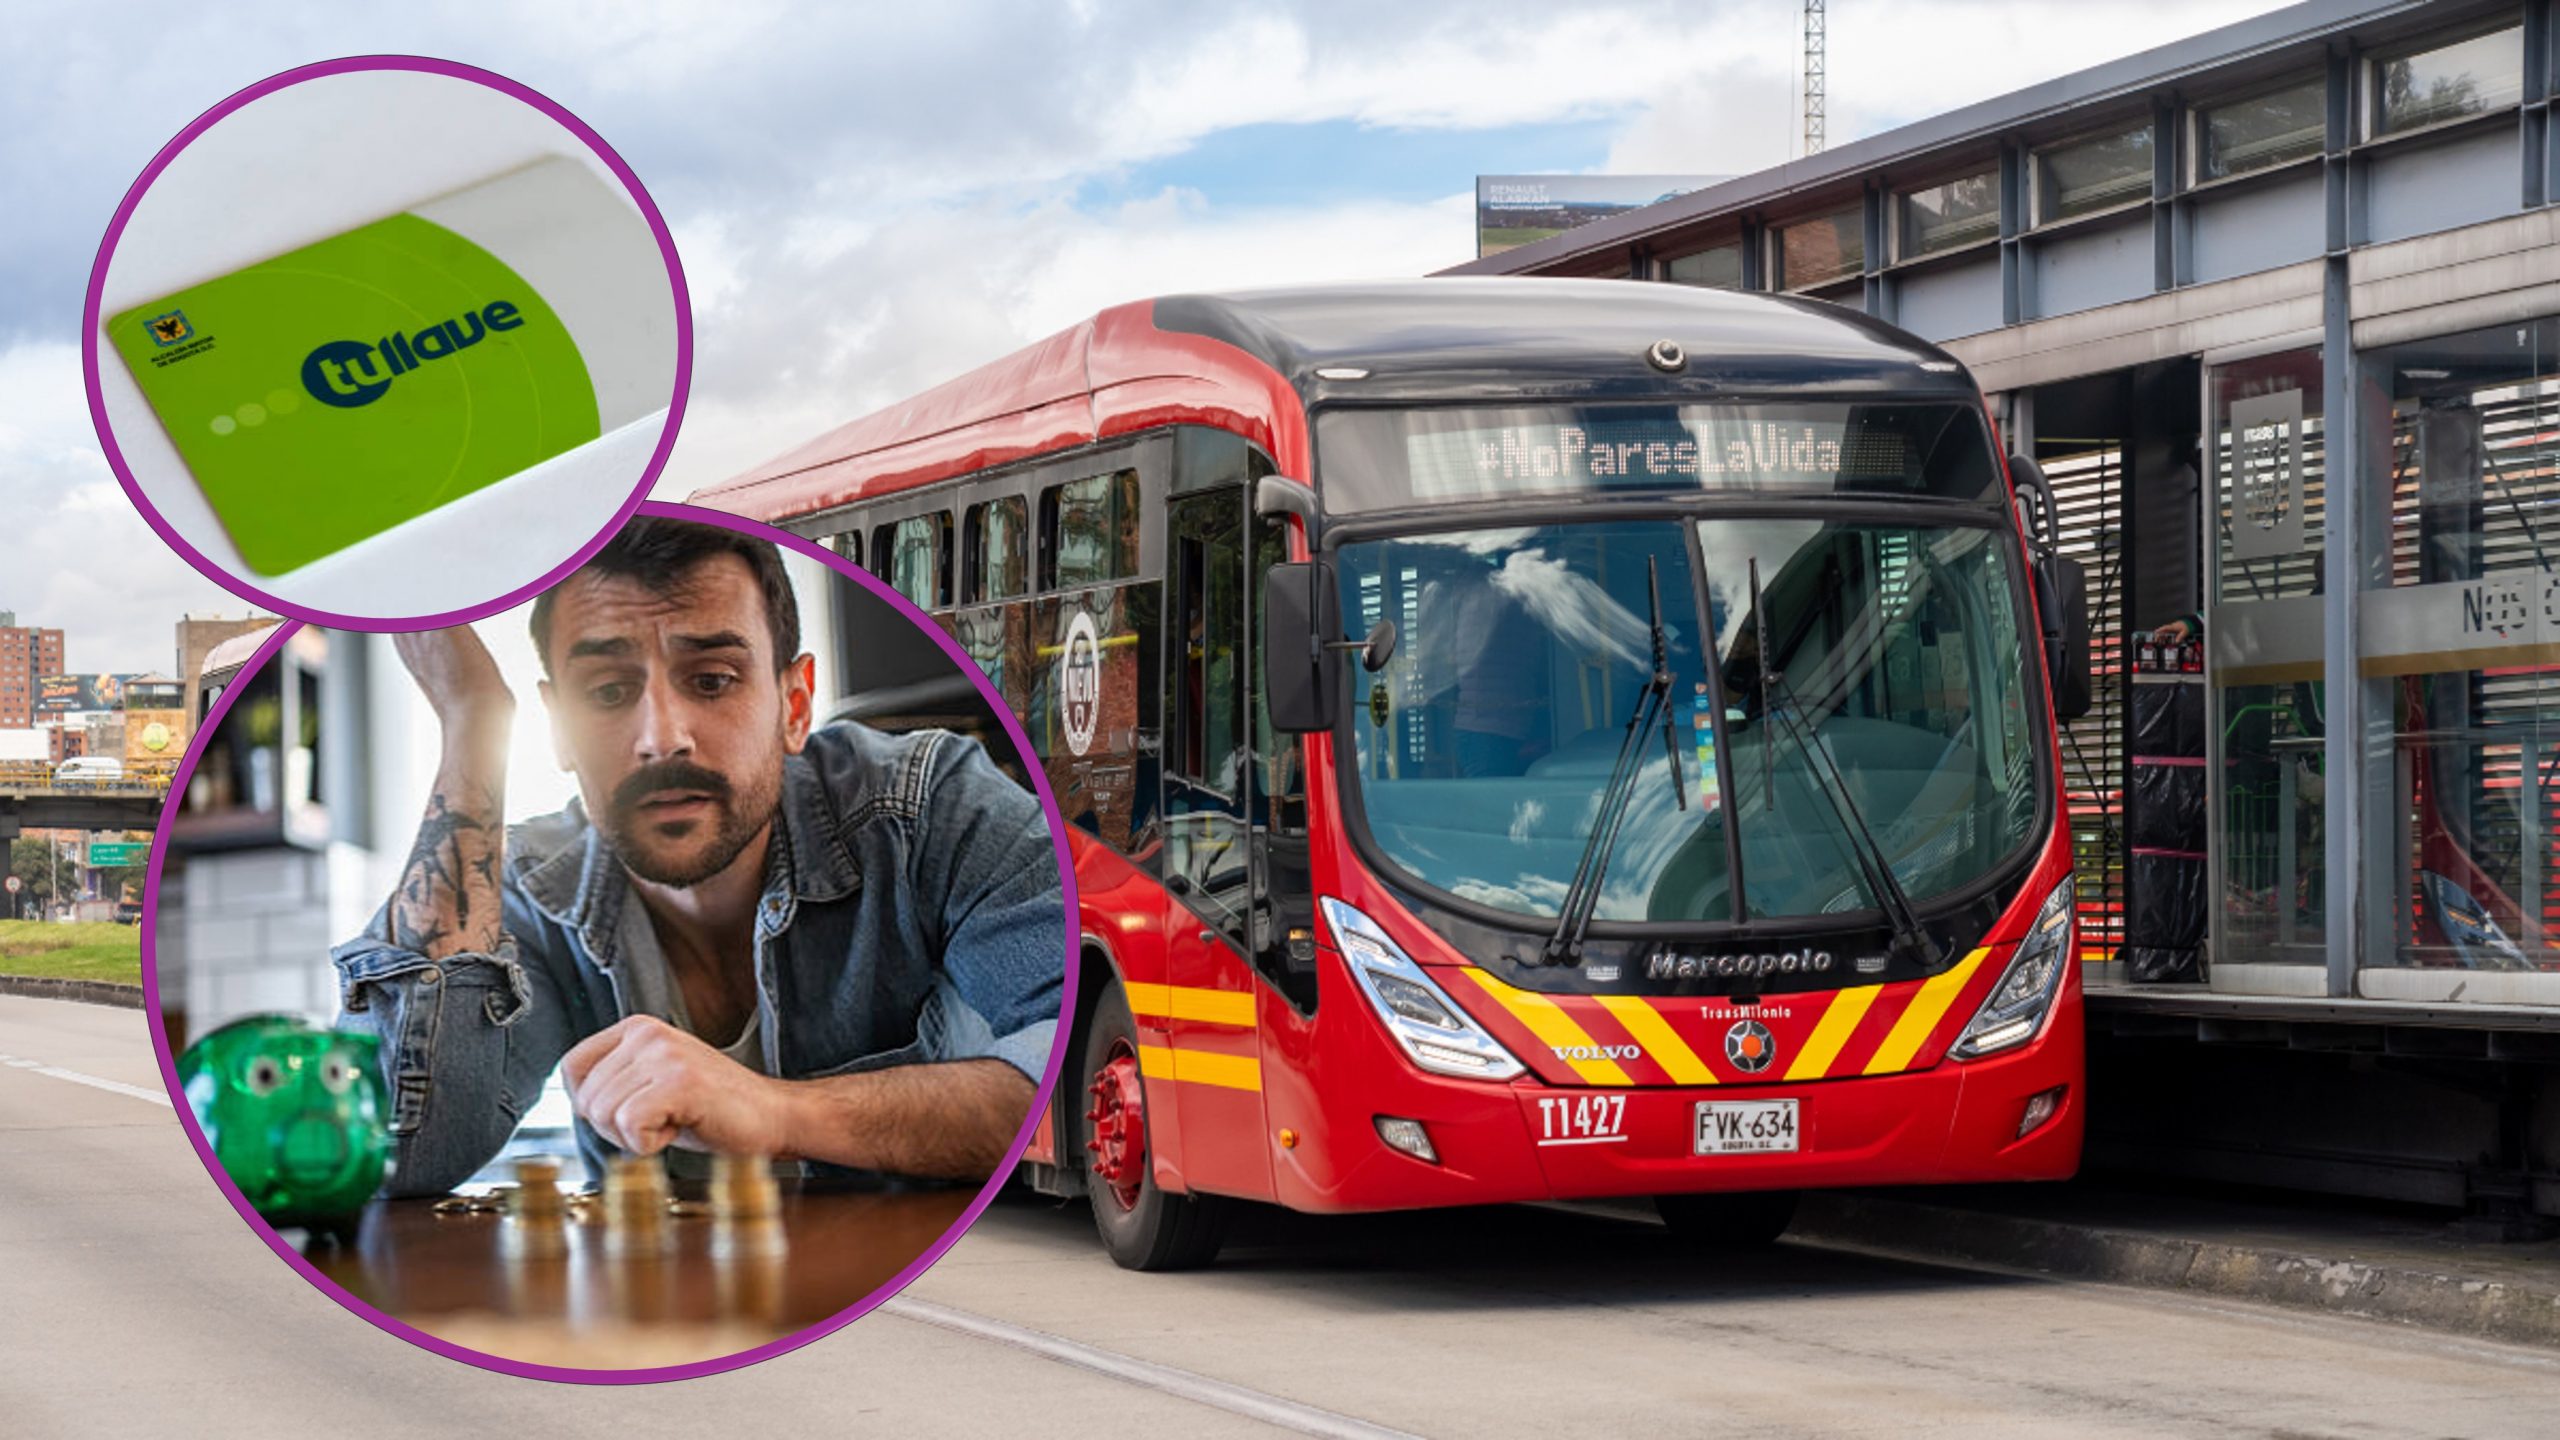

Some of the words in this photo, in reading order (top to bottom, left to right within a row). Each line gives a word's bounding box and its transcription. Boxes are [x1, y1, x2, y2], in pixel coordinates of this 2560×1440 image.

[302, 300, 525, 408] tullave
[1477, 424, 1840, 479] #NoParesLaVida
[1647, 948, 1832, 979] Marcopolo
[1551, 1044, 1641, 1060] VOLVO
[1538, 1094, 1627, 1137] T1427
[1700, 1110, 1795, 1139] FVK-634
